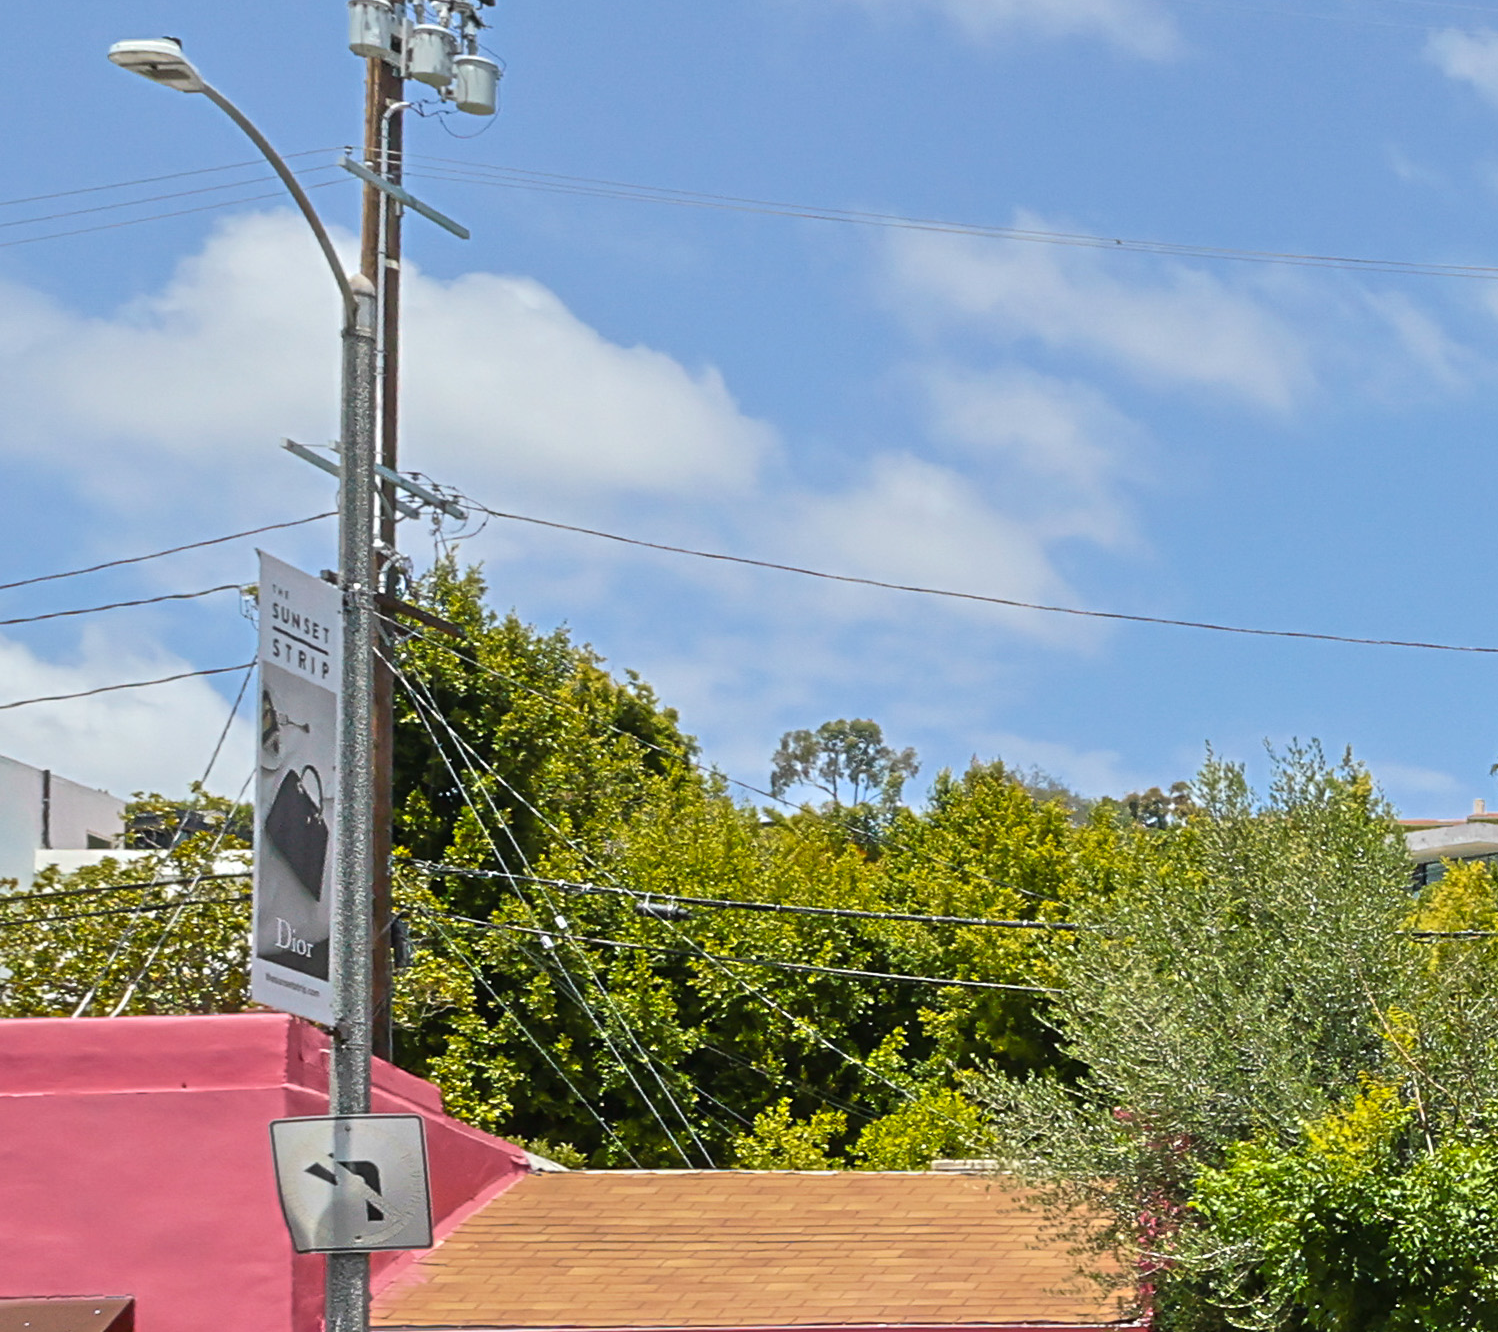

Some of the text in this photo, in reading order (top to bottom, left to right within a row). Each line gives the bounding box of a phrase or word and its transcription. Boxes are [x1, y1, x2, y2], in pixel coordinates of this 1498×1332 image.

[272, 602, 329, 644] SUNSET
[272, 638, 330, 679] STRIP
[275, 916, 314, 958] Dior
